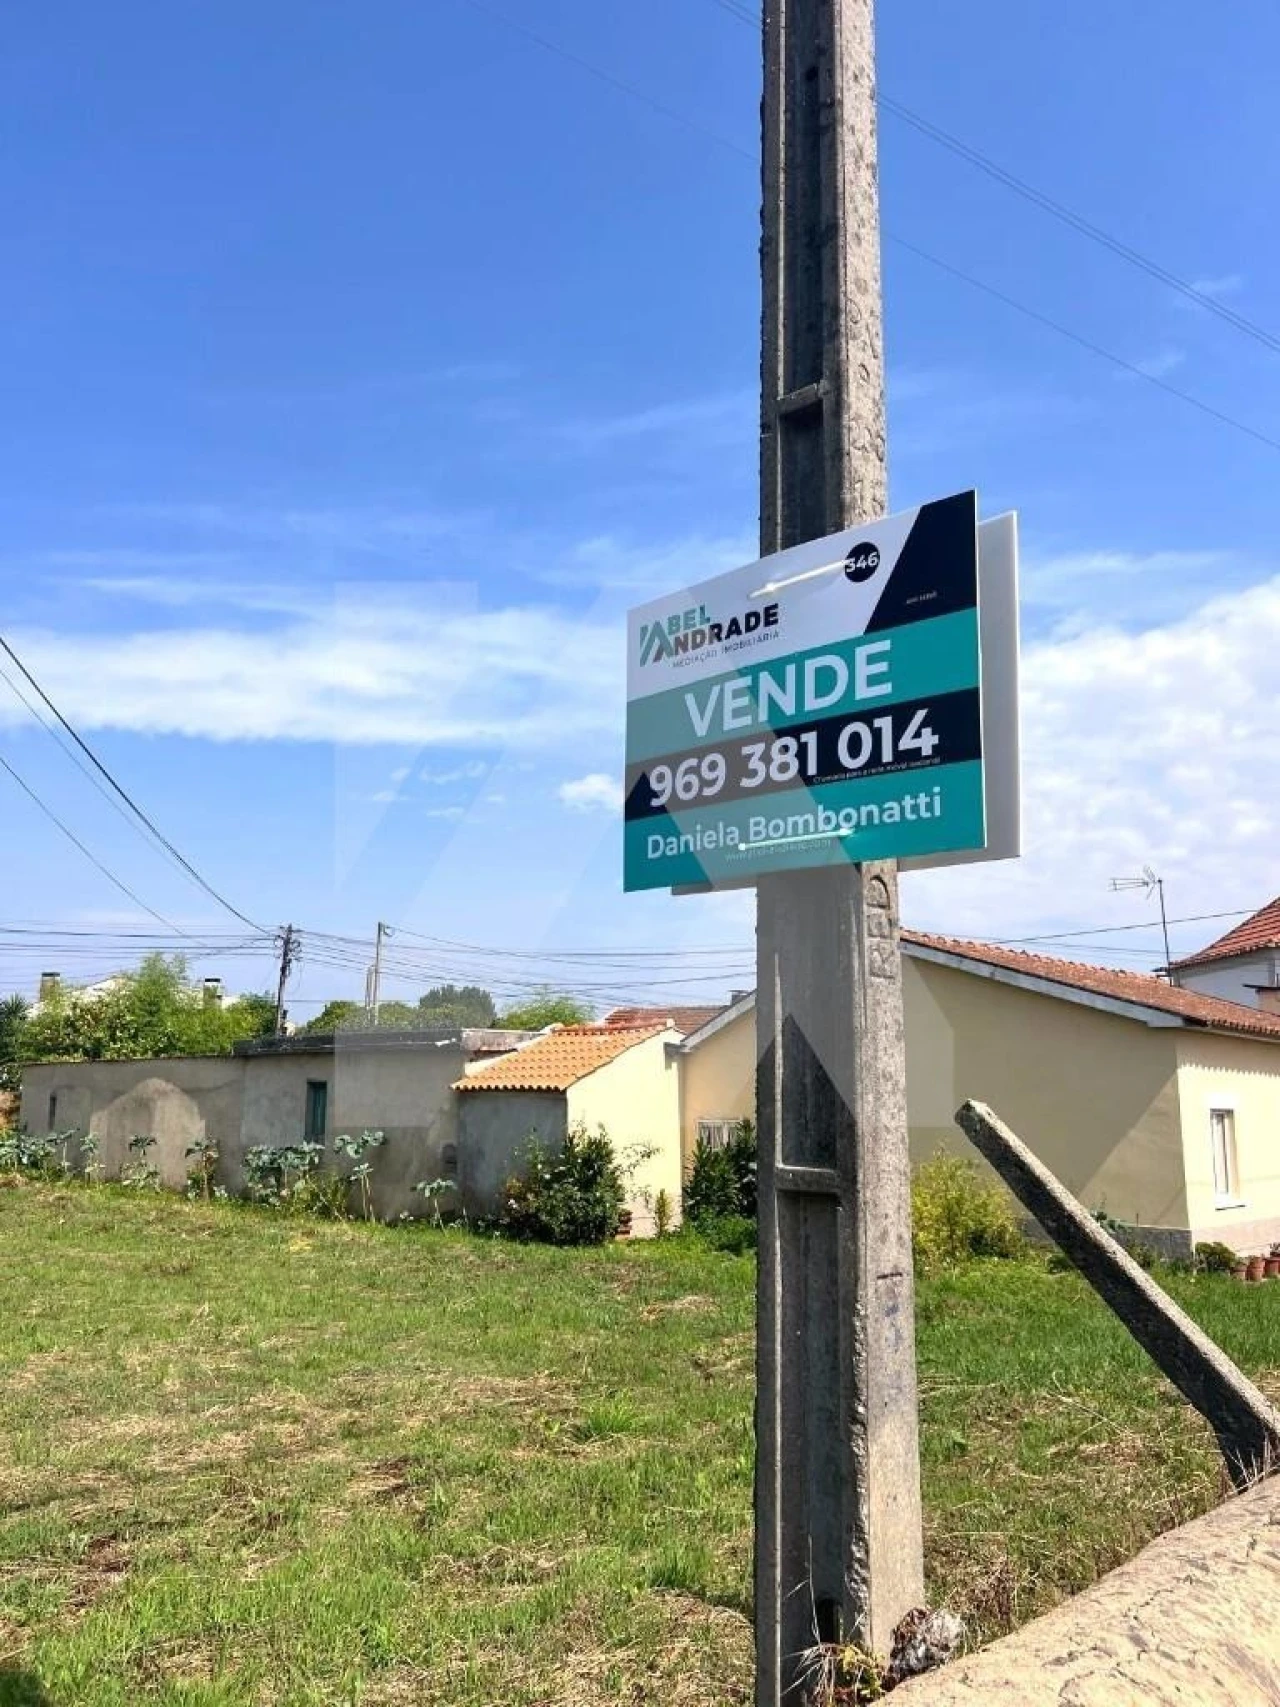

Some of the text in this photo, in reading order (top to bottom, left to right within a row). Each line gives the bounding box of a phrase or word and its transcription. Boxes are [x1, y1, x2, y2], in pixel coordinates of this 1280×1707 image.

[685, 639, 893, 738] VENDE
[649, 753, 726, 808] 969
[740, 731, 818, 788] 381
[837, 708, 939, 769] 014
[647, 828, 739, 860] Daniela
[749, 786, 941, 841] Bombonatti
